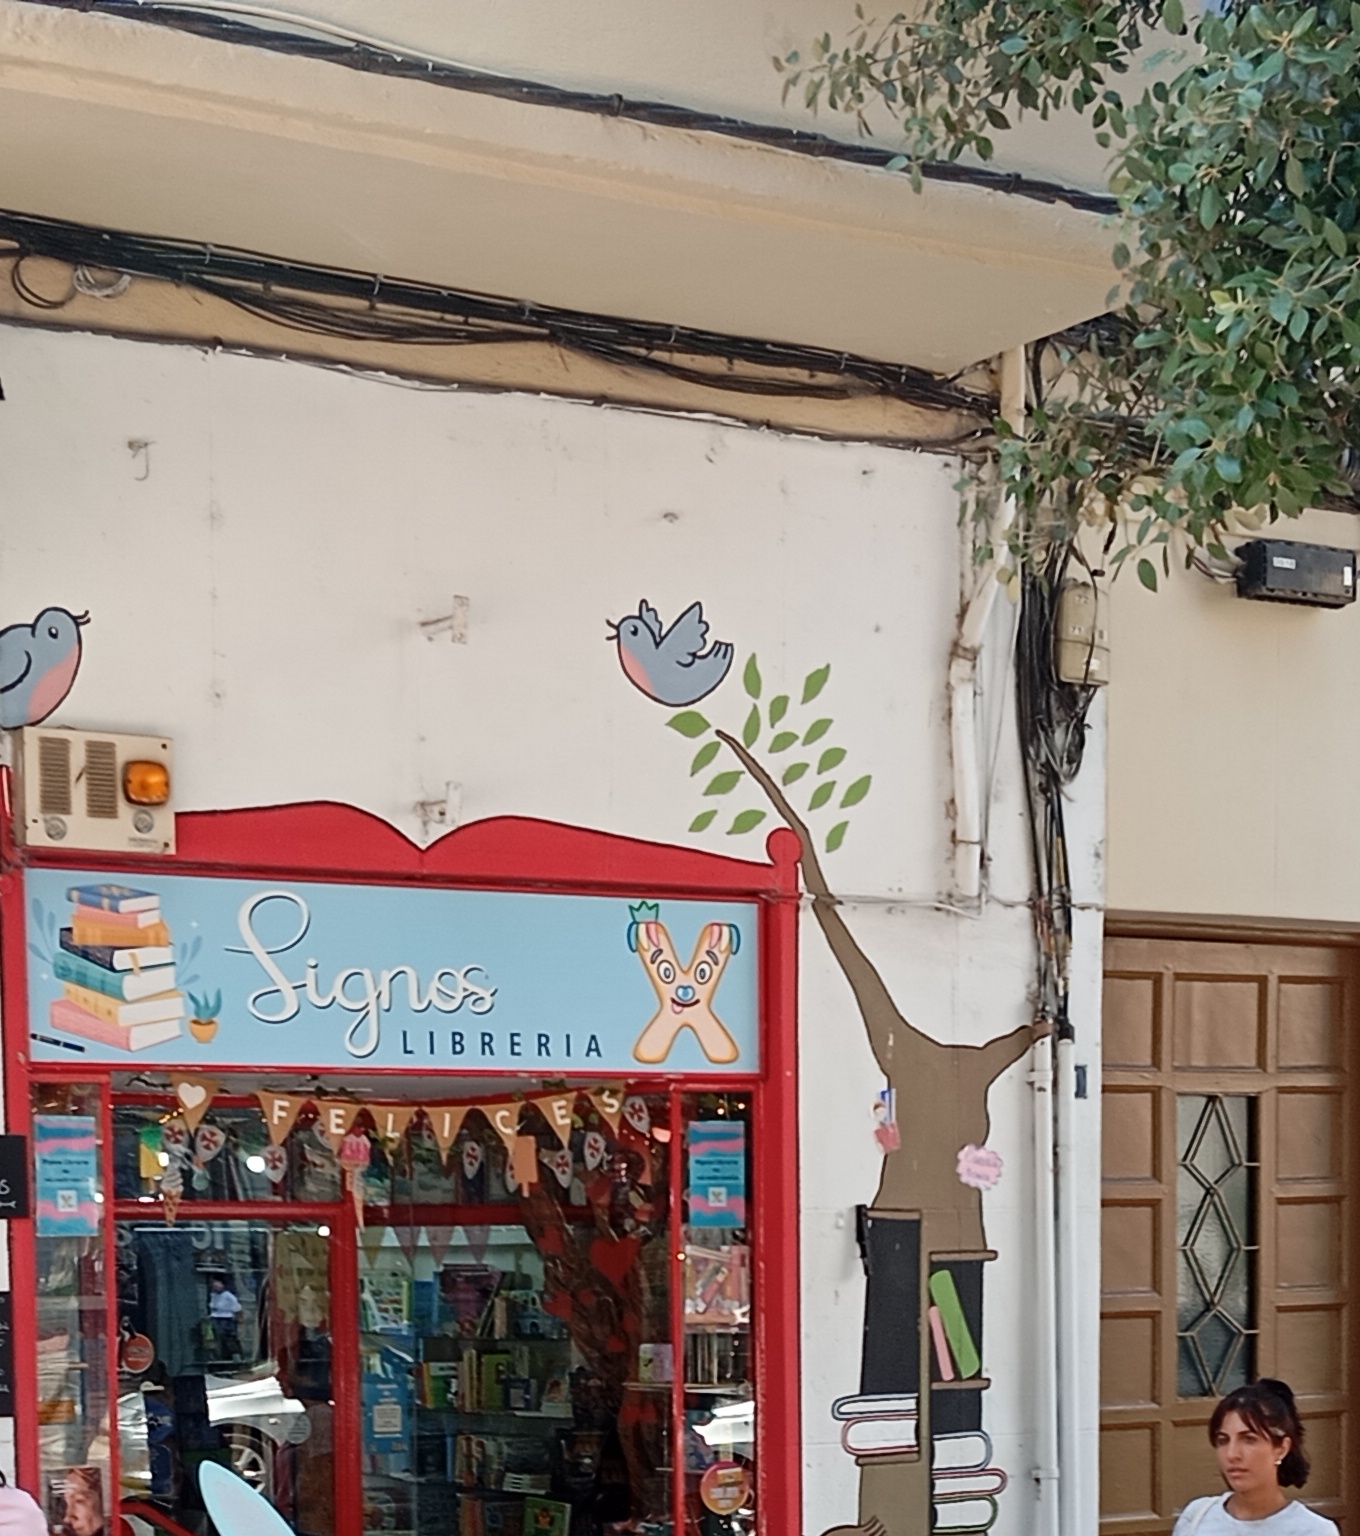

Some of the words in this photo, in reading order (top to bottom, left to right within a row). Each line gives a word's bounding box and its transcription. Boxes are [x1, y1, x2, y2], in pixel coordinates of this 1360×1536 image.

[223, 889, 498, 1058] Signos
[401, 1030, 602, 1058] LIBRERIA
[272, 1091, 620, 1138] FELICES
